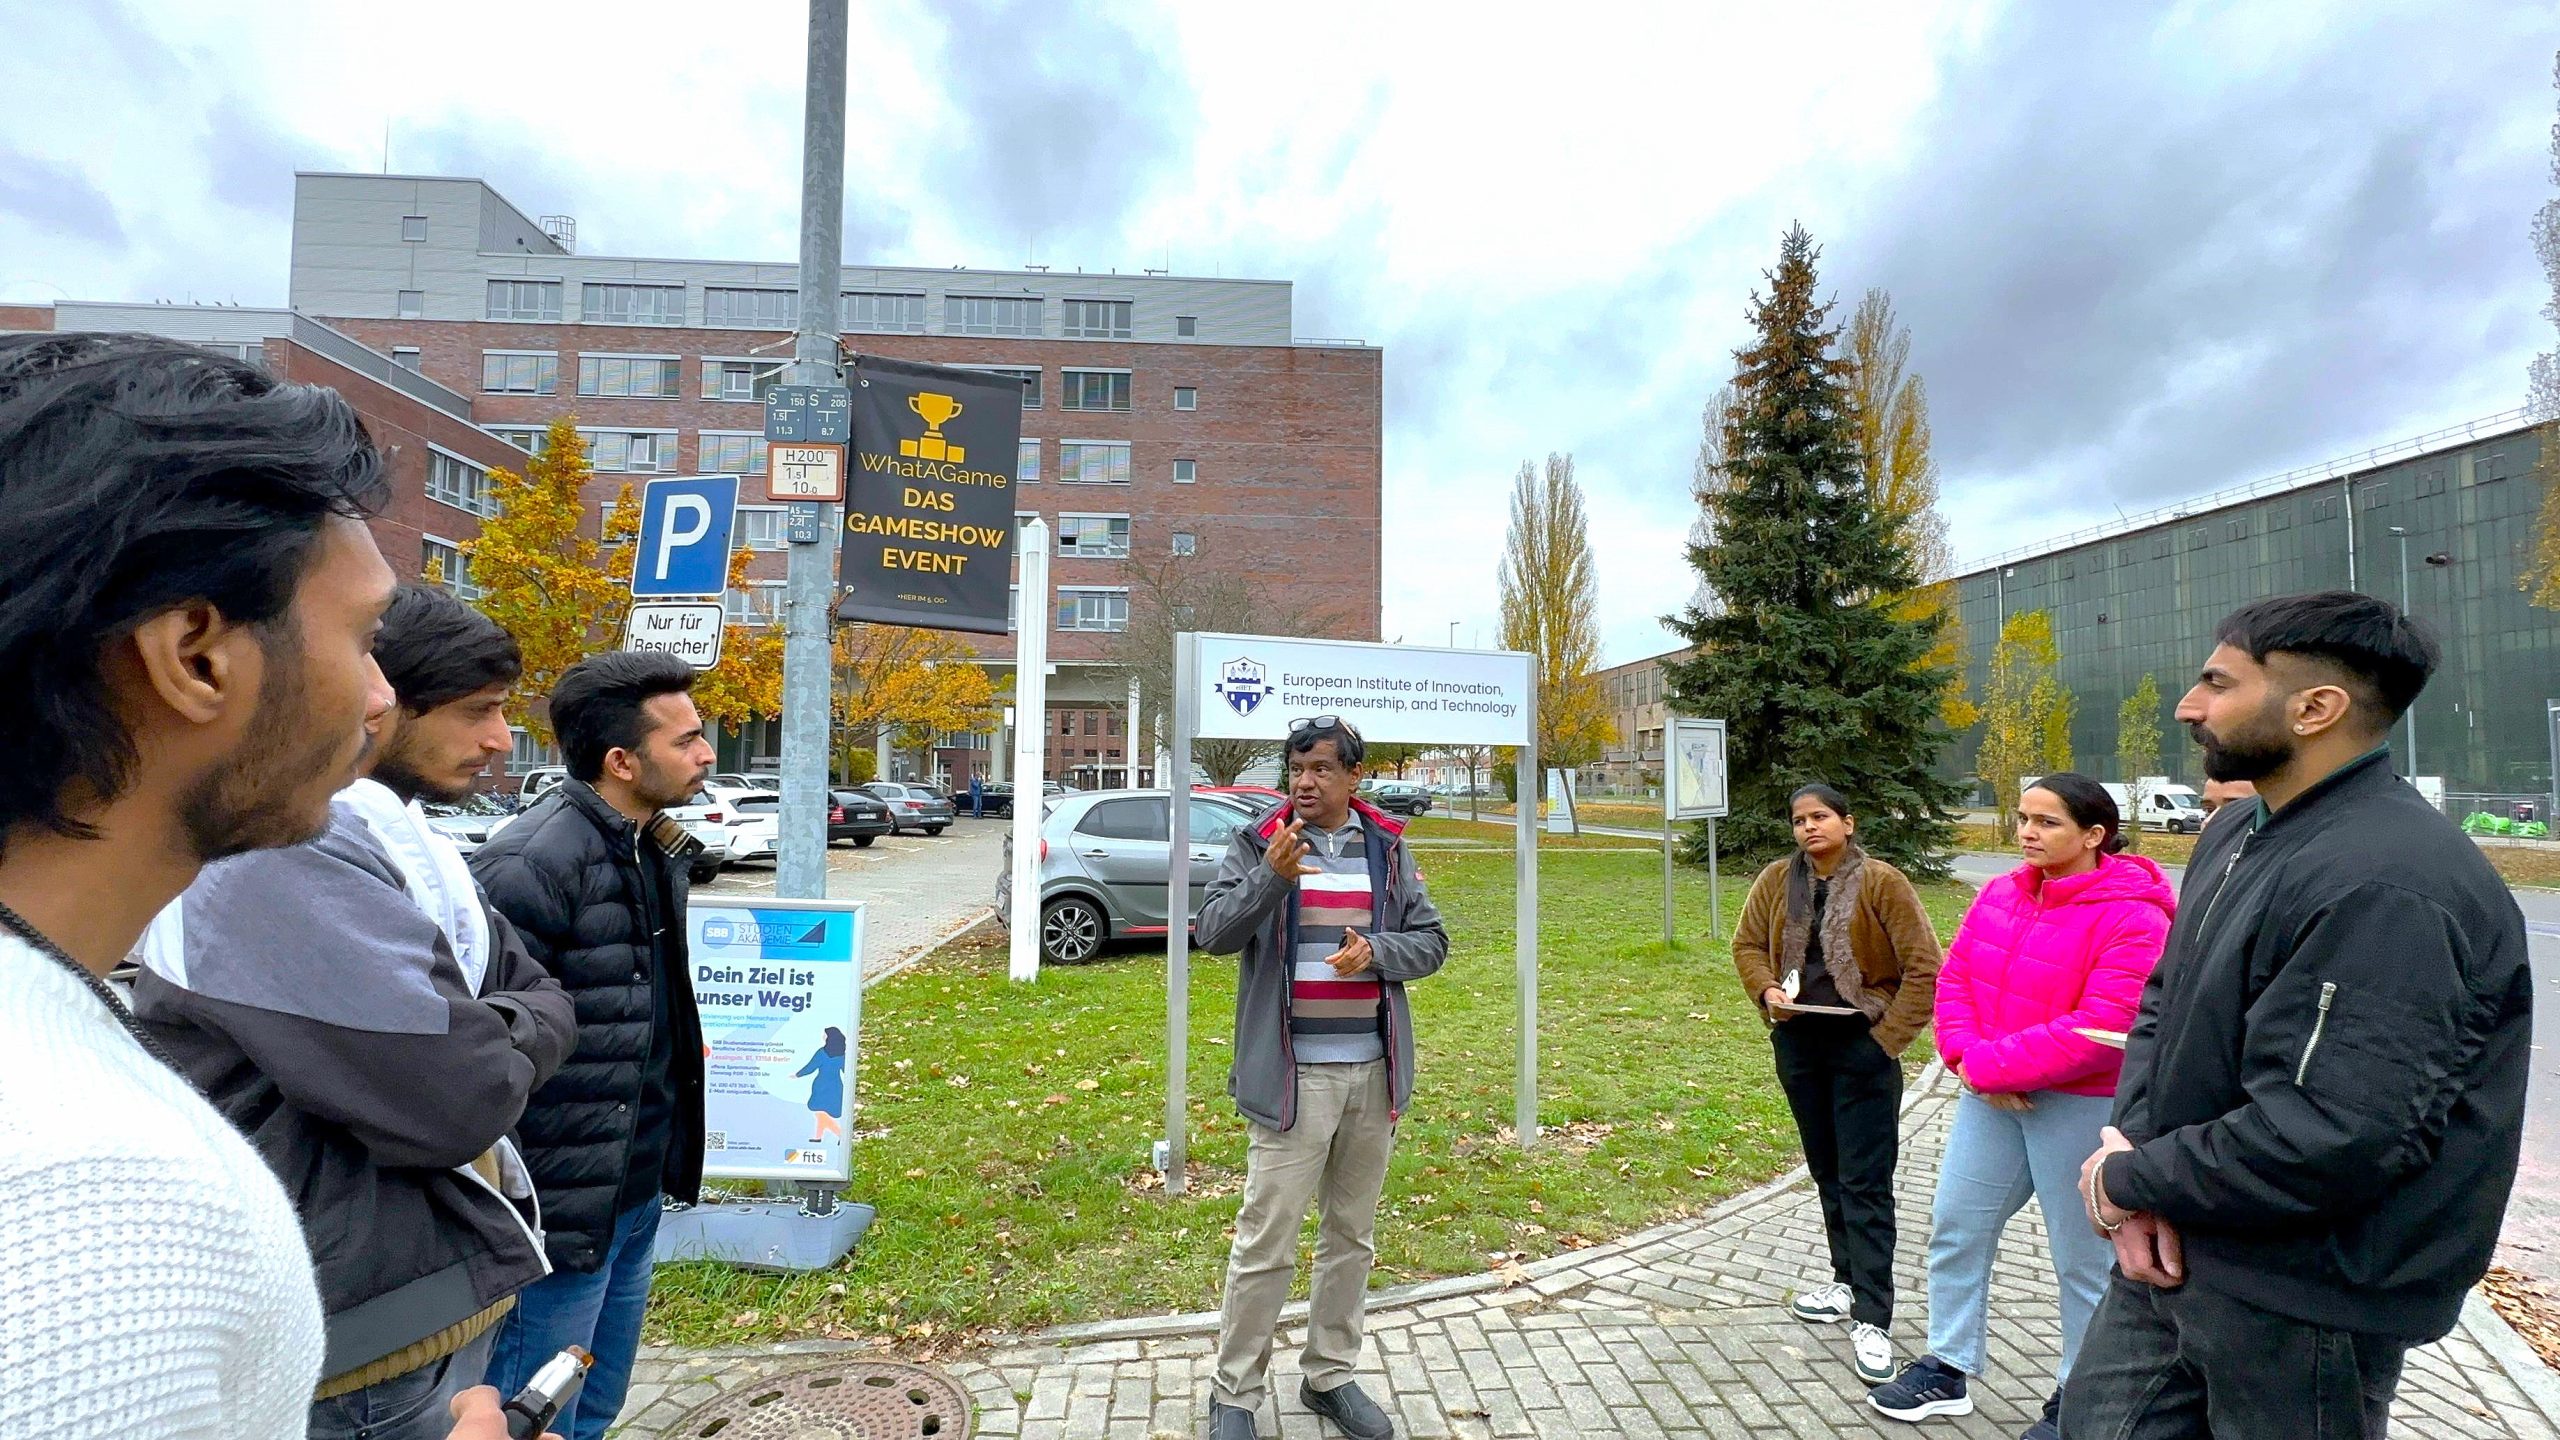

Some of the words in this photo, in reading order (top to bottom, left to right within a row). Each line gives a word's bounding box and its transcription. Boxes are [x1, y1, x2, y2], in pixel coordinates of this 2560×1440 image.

[768, 393, 777, 405] S
[790, 398, 806, 406] 150
[809, 394, 819, 406] S
[830, 399, 847, 408] 200
[860, 452, 1007, 489] WhatAGame
[904, 487, 955, 512] DAS
[655, 494, 711, 580] P
[847, 513, 1005, 549] GAMESHOW
[883, 547, 968, 576] EVENT
[647, 614, 674, 630] Nur
[680, 613, 702, 630] für
[634, 638, 710, 655] Besucher
[1283, 673, 1352, 691] European
[1356, 676, 1412, 691] Institute
[1415, 680, 1429, 692] of
[1432, 680, 1504, 698] Innovation,
[1283, 692, 1408, 714] Entrepreneurship,
[1411, 698, 1438, 711] and
[1441, 699, 1517, 718] Technology
[706, 927, 729, 939] SBB
[739, 923, 792, 935] STUDIEN
[737, 934, 791, 945] AKADEMIE
[698, 966, 744, 984] Dein
[748, 967, 784, 986] Ziel
[789, 968, 814, 987] ist
[696, 992, 753, 1007] unser
[758, 990, 812, 1013] Weg!
[802, 1151, 823, 1163] fits
